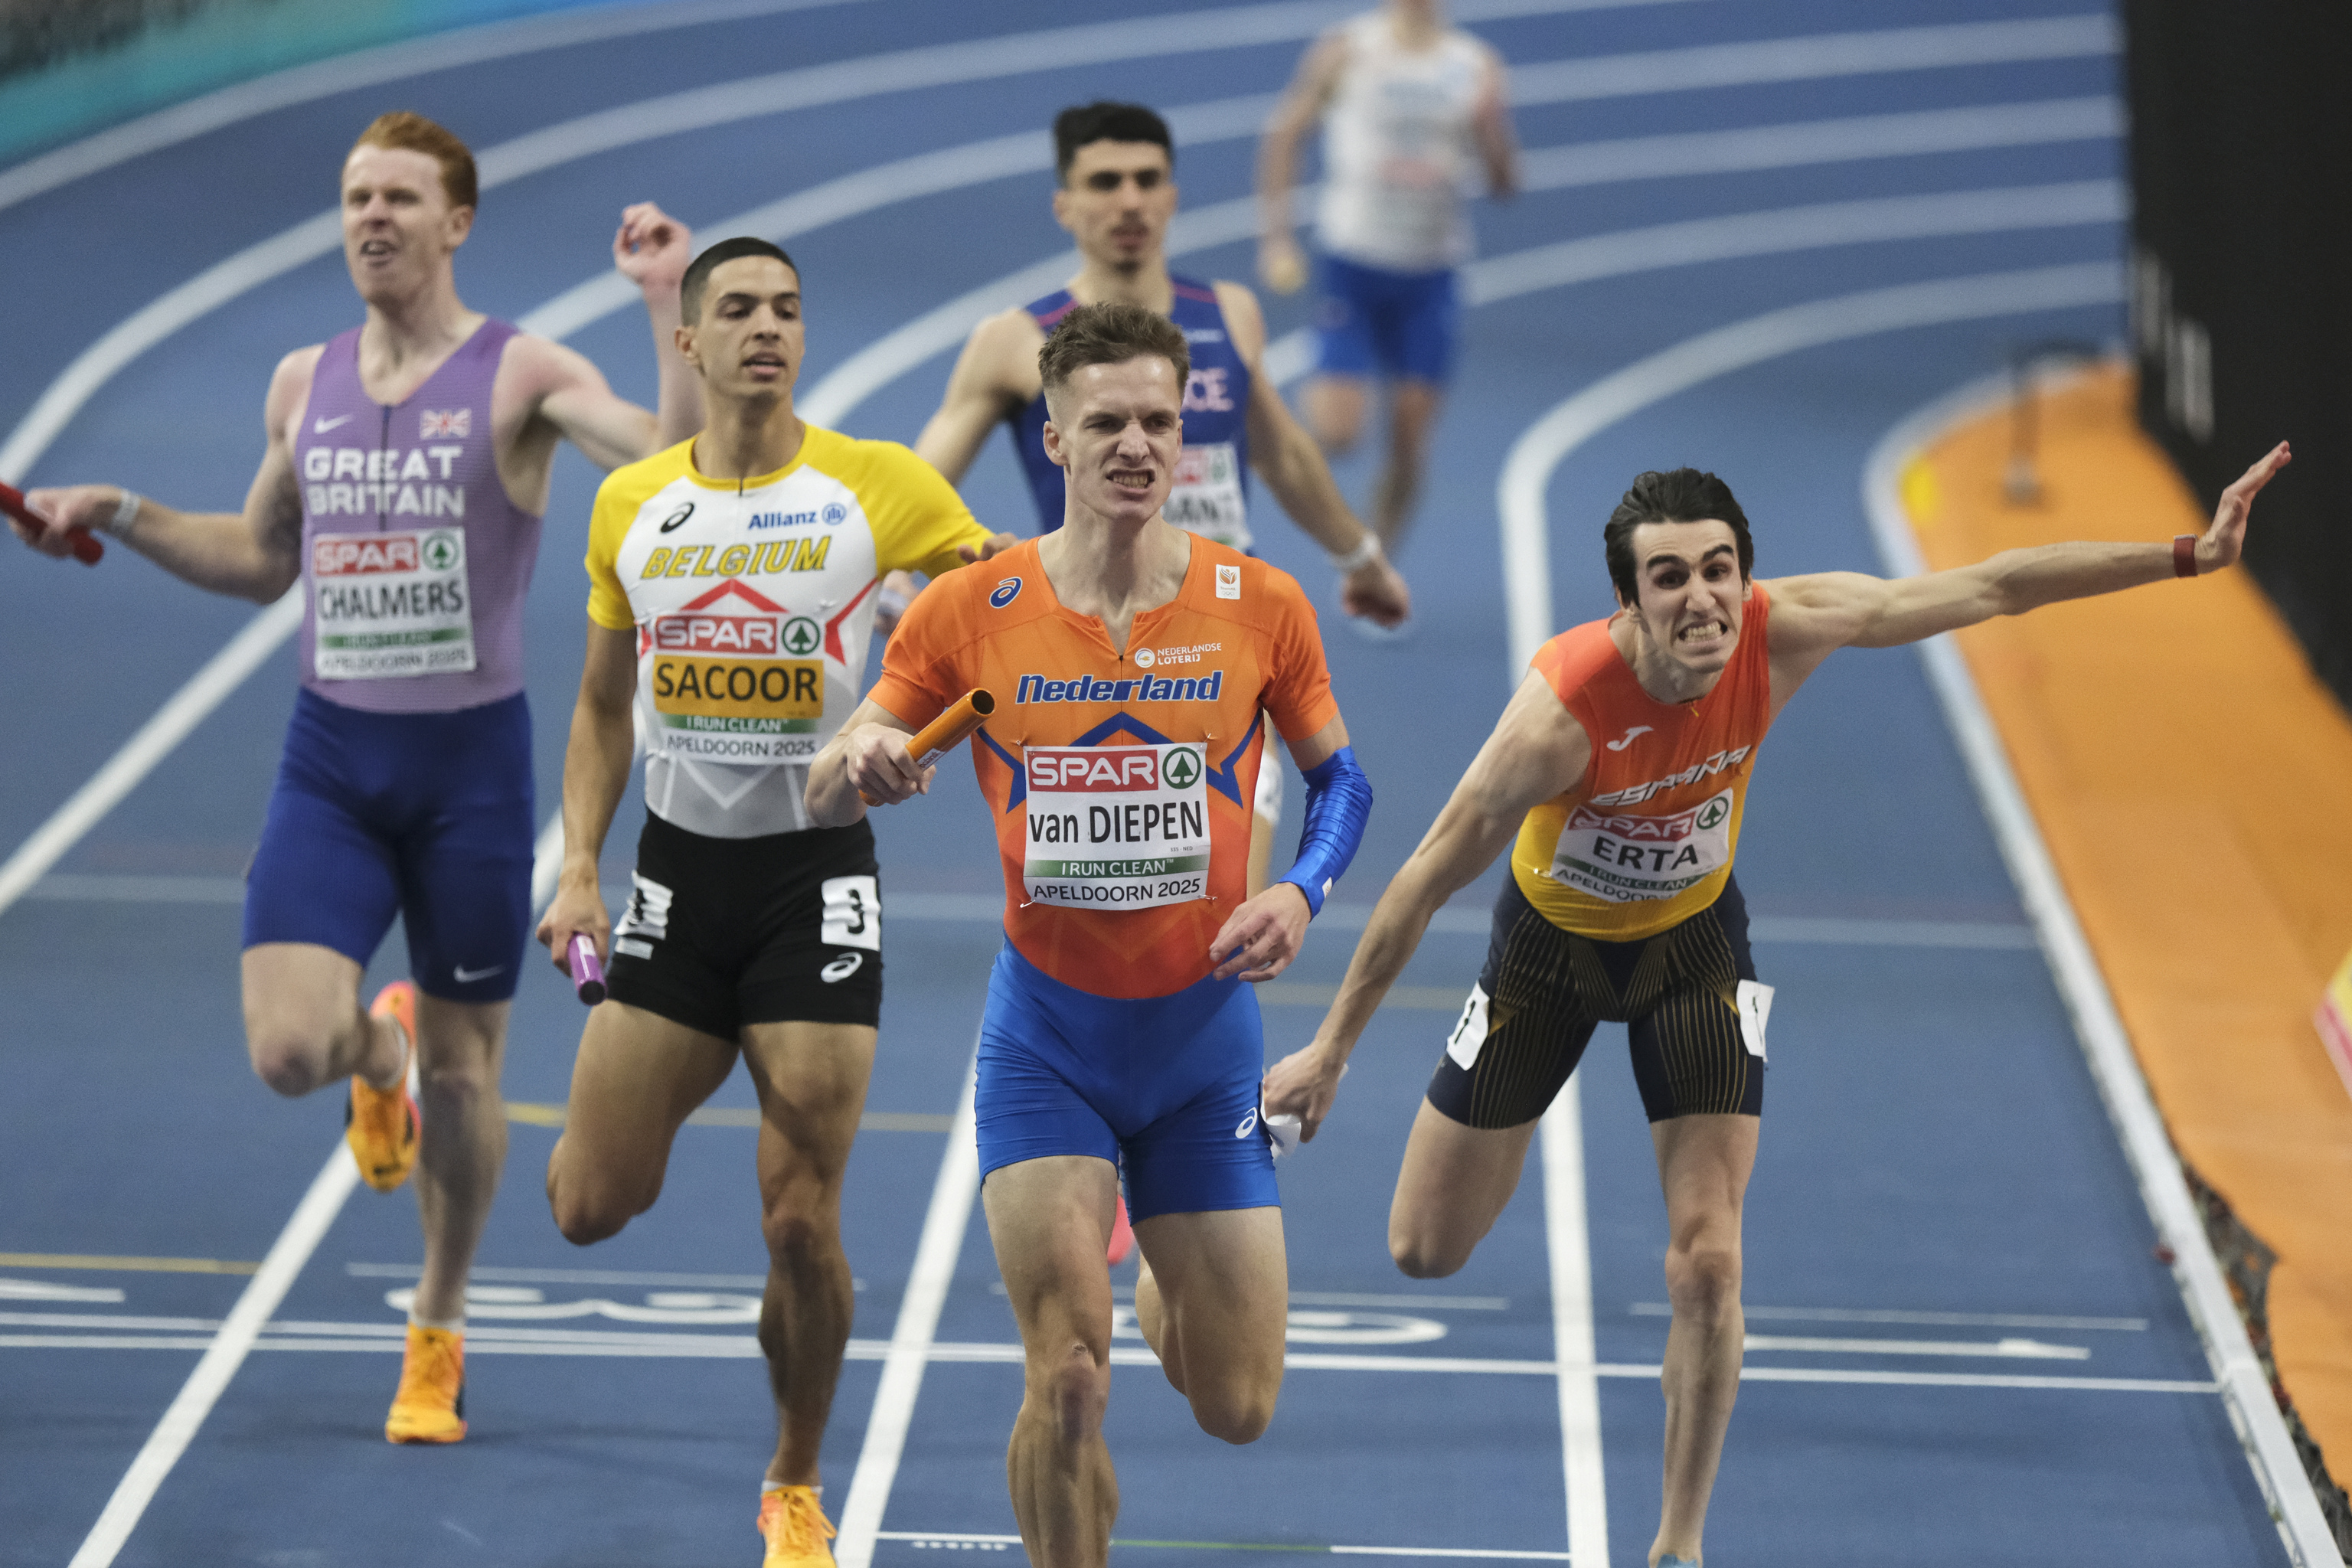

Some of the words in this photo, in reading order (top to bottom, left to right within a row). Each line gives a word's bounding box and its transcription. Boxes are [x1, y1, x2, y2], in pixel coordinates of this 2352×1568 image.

[305, 446, 463, 481] GREAT
[308, 483, 466, 518] BRITAIN
[747, 510, 818, 530] Allianz
[315, 540, 417, 572] SPAR
[640, 535, 832, 579] BELGIUM
[318, 580, 464, 621] CHALMERS
[658, 618, 774, 649] SPAR
[1157, 642, 1222, 657] NEDERLANDSE
[1157, 653, 1200, 665] LOTERIJ
[656, 663, 818, 703] SACOOR
[1015, 670, 1223, 704] Nederland
[693, 716, 727, 731] RUN
[667, 734, 769, 756] APELDOORN
[774, 740, 815, 756] 2025
[1031, 755, 1155, 787] SPAR
[1029, 813, 1079, 843] van
[1089, 800, 1204, 843] DIEPEN
[1574, 816, 1692, 838] SPAR
[1061, 862, 1066, 876] I
[1070, 862, 1105, 876] RUN
[1592, 835, 1699, 872] ERTA
[1034, 884, 1153, 902] APELDOORN
[1158, 878, 1200, 898] 2025
